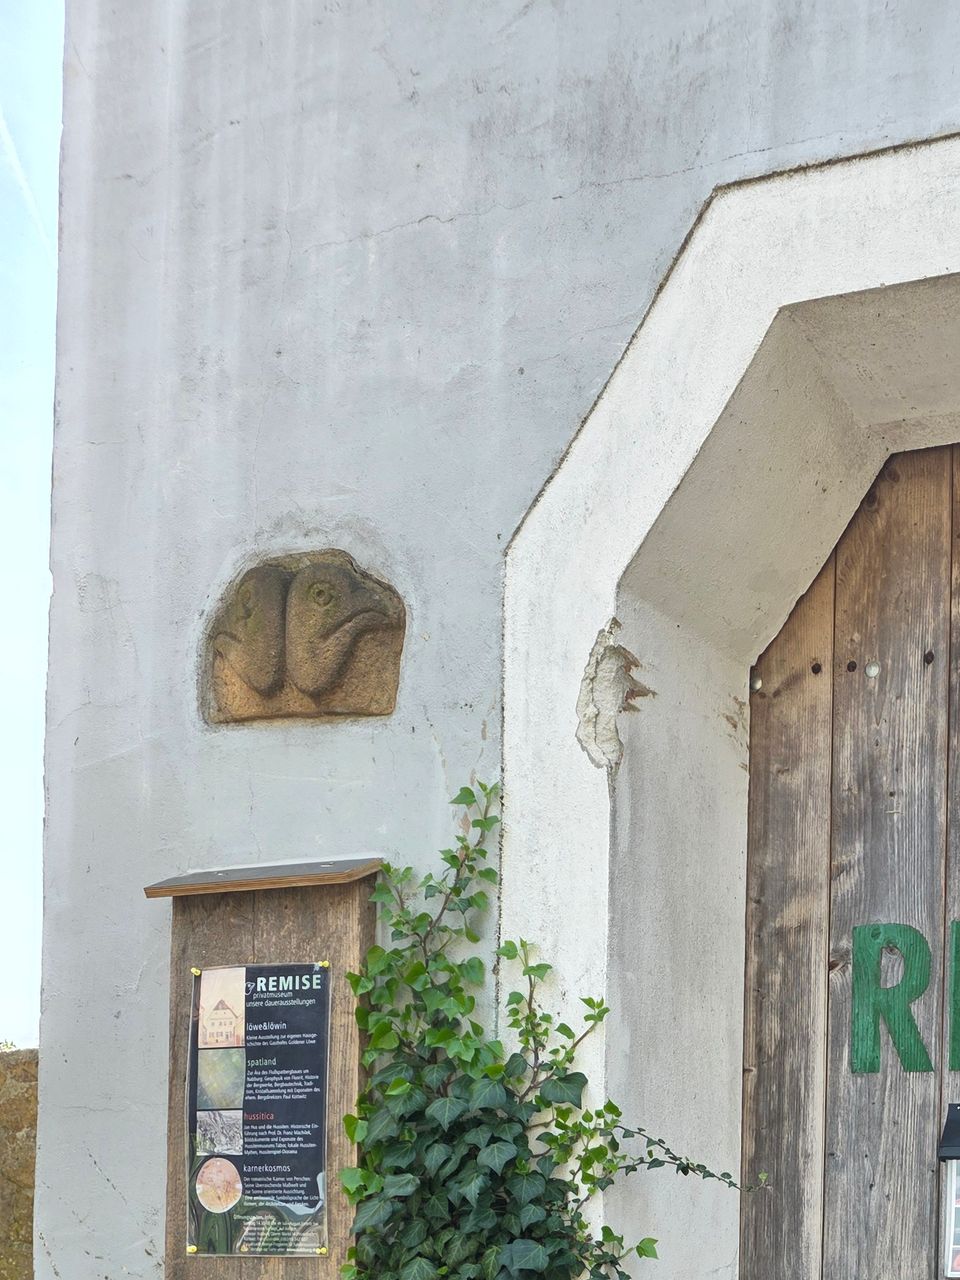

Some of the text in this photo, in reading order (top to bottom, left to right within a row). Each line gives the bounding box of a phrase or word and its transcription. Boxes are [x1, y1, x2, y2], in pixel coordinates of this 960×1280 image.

[256, 974, 322, 992] REMISE
[252, 991, 293, 1000] privatmuseum
[264, 998, 316, 1007] dauerausstellungen
[246, 1021, 287, 1031] löwe&löwin
[247, 1057, 277, 1067] spatland
[244, 1112, 274, 1121] hussitica
[243, 1163, 291, 1172] karnerkosmos
